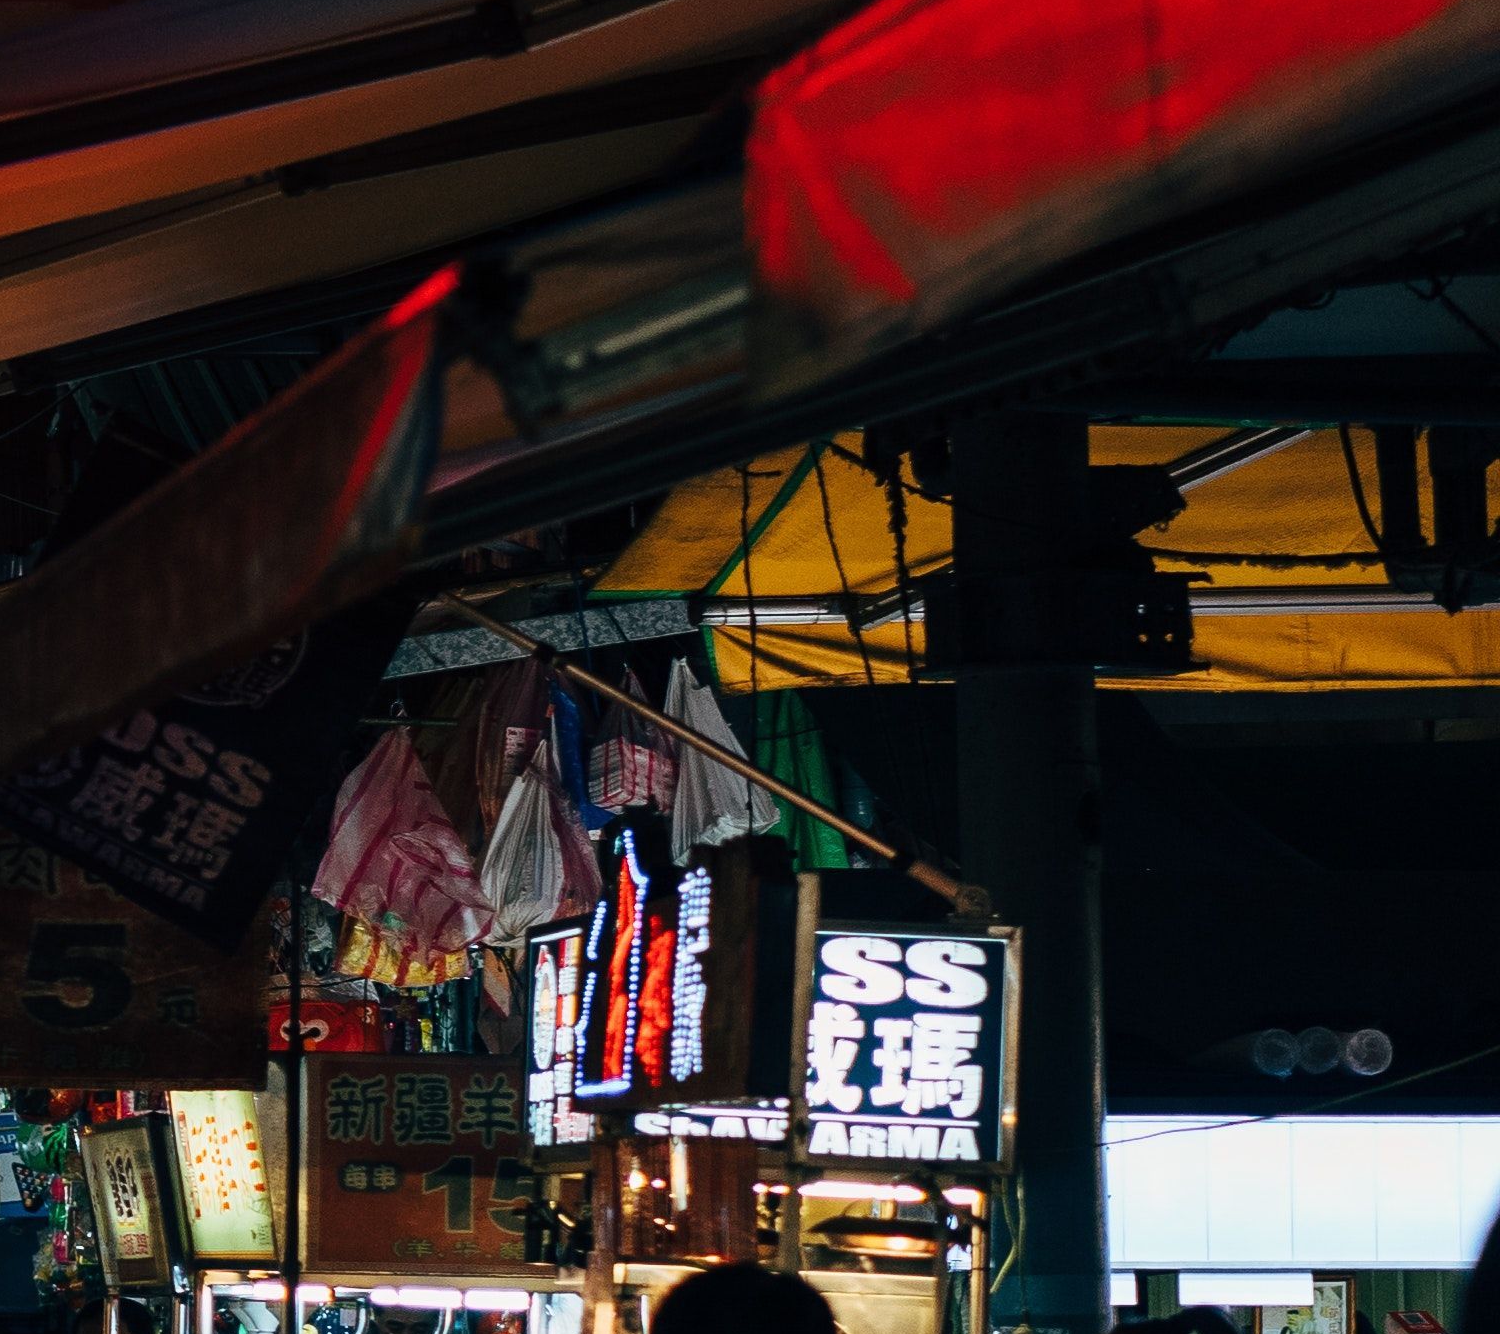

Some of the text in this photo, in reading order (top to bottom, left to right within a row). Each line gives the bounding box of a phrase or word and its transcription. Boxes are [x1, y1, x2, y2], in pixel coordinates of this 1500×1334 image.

[155, 986, 201, 1029] 元
[325, 1072, 519, 1150] 新疆羊
[342, 1163, 398, 1192] 每串
[421, 1154, 533, 1236] 15
